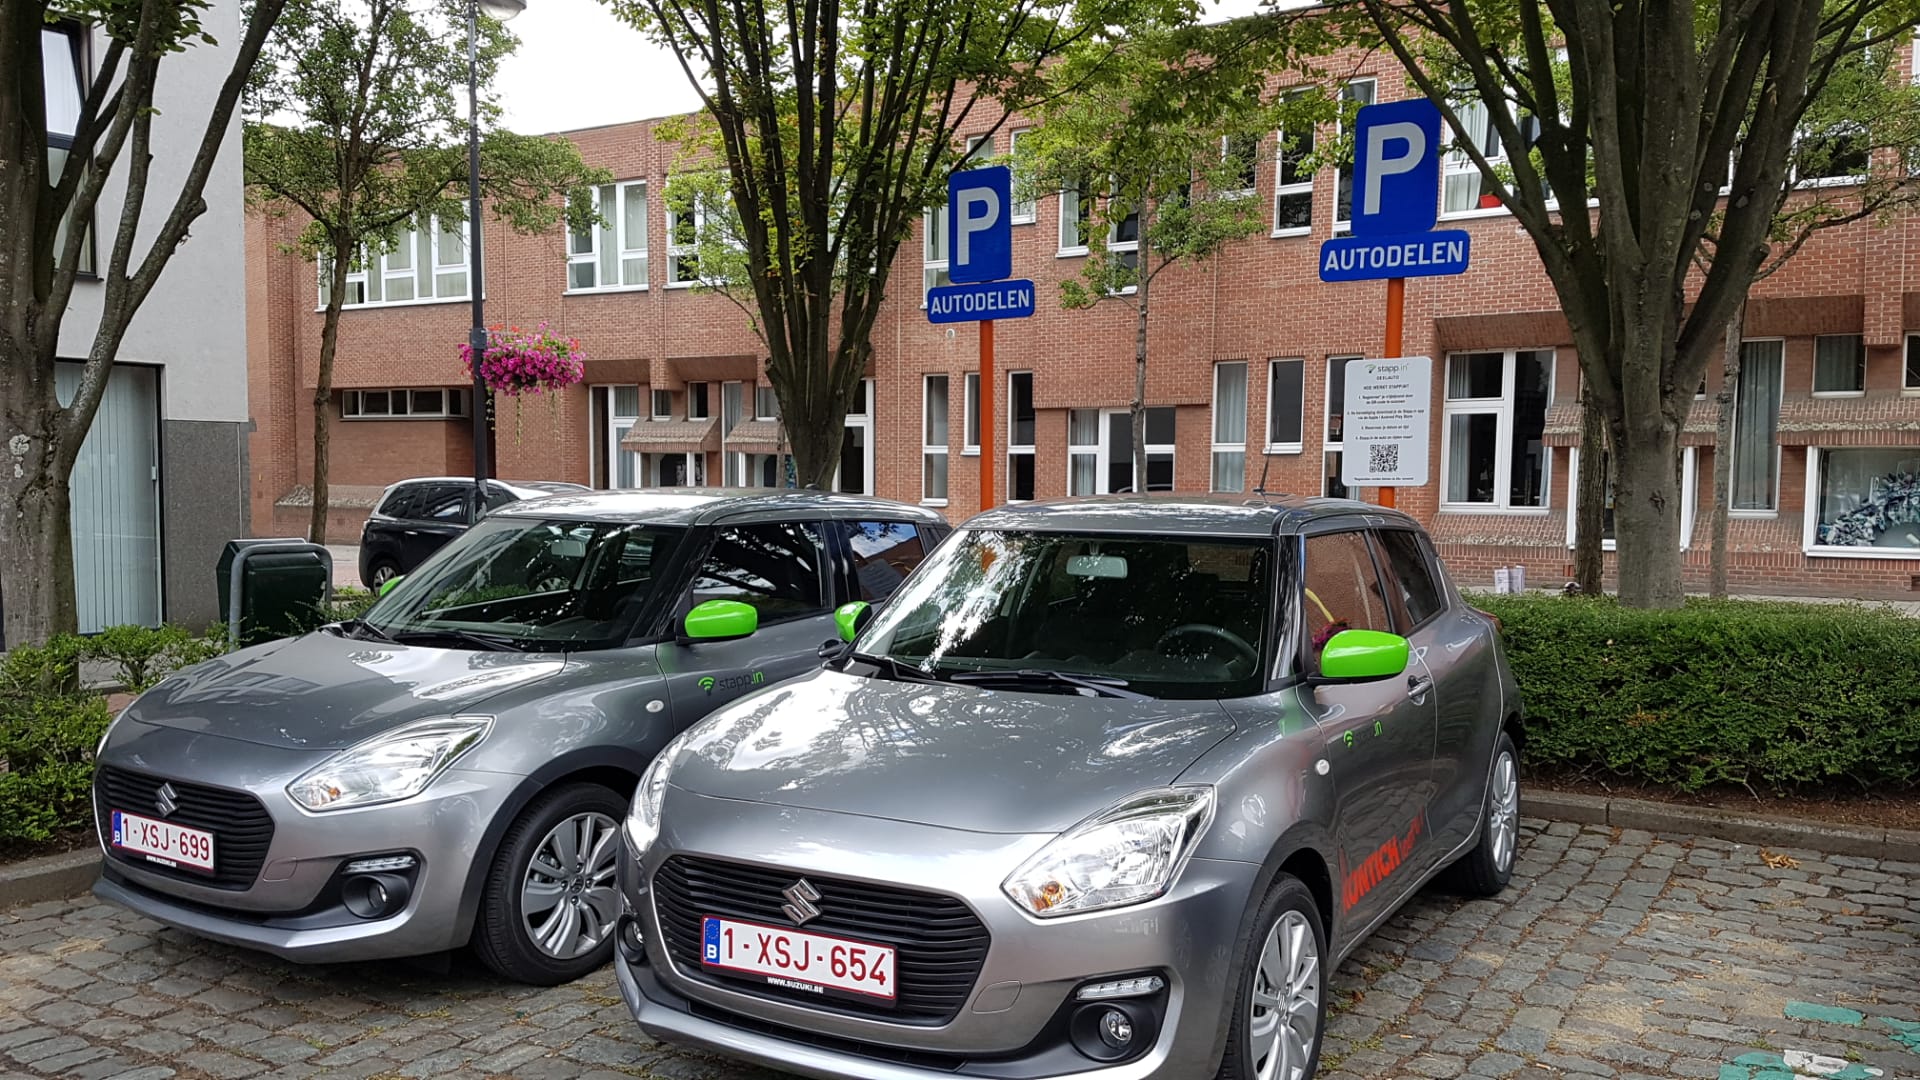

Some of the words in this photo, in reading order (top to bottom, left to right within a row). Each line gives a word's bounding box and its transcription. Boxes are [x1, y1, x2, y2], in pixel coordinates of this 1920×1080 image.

[1364, 122, 1426, 216] P
[957, 187, 1000, 266] P
[1324, 241, 1464, 272] AUTODELEN
[930, 289, 1030, 315] AUTODELEN
[719, 670, 765, 692] stapp.in
[114, 830, 121, 842] B
[122, 818, 210, 861] 1-XSJ-699
[707, 944, 717, 959] B
[724, 928, 887, 986] 1-XSJ-654
[767, 976, 824, 994] WWW.SUZUKI.BE
